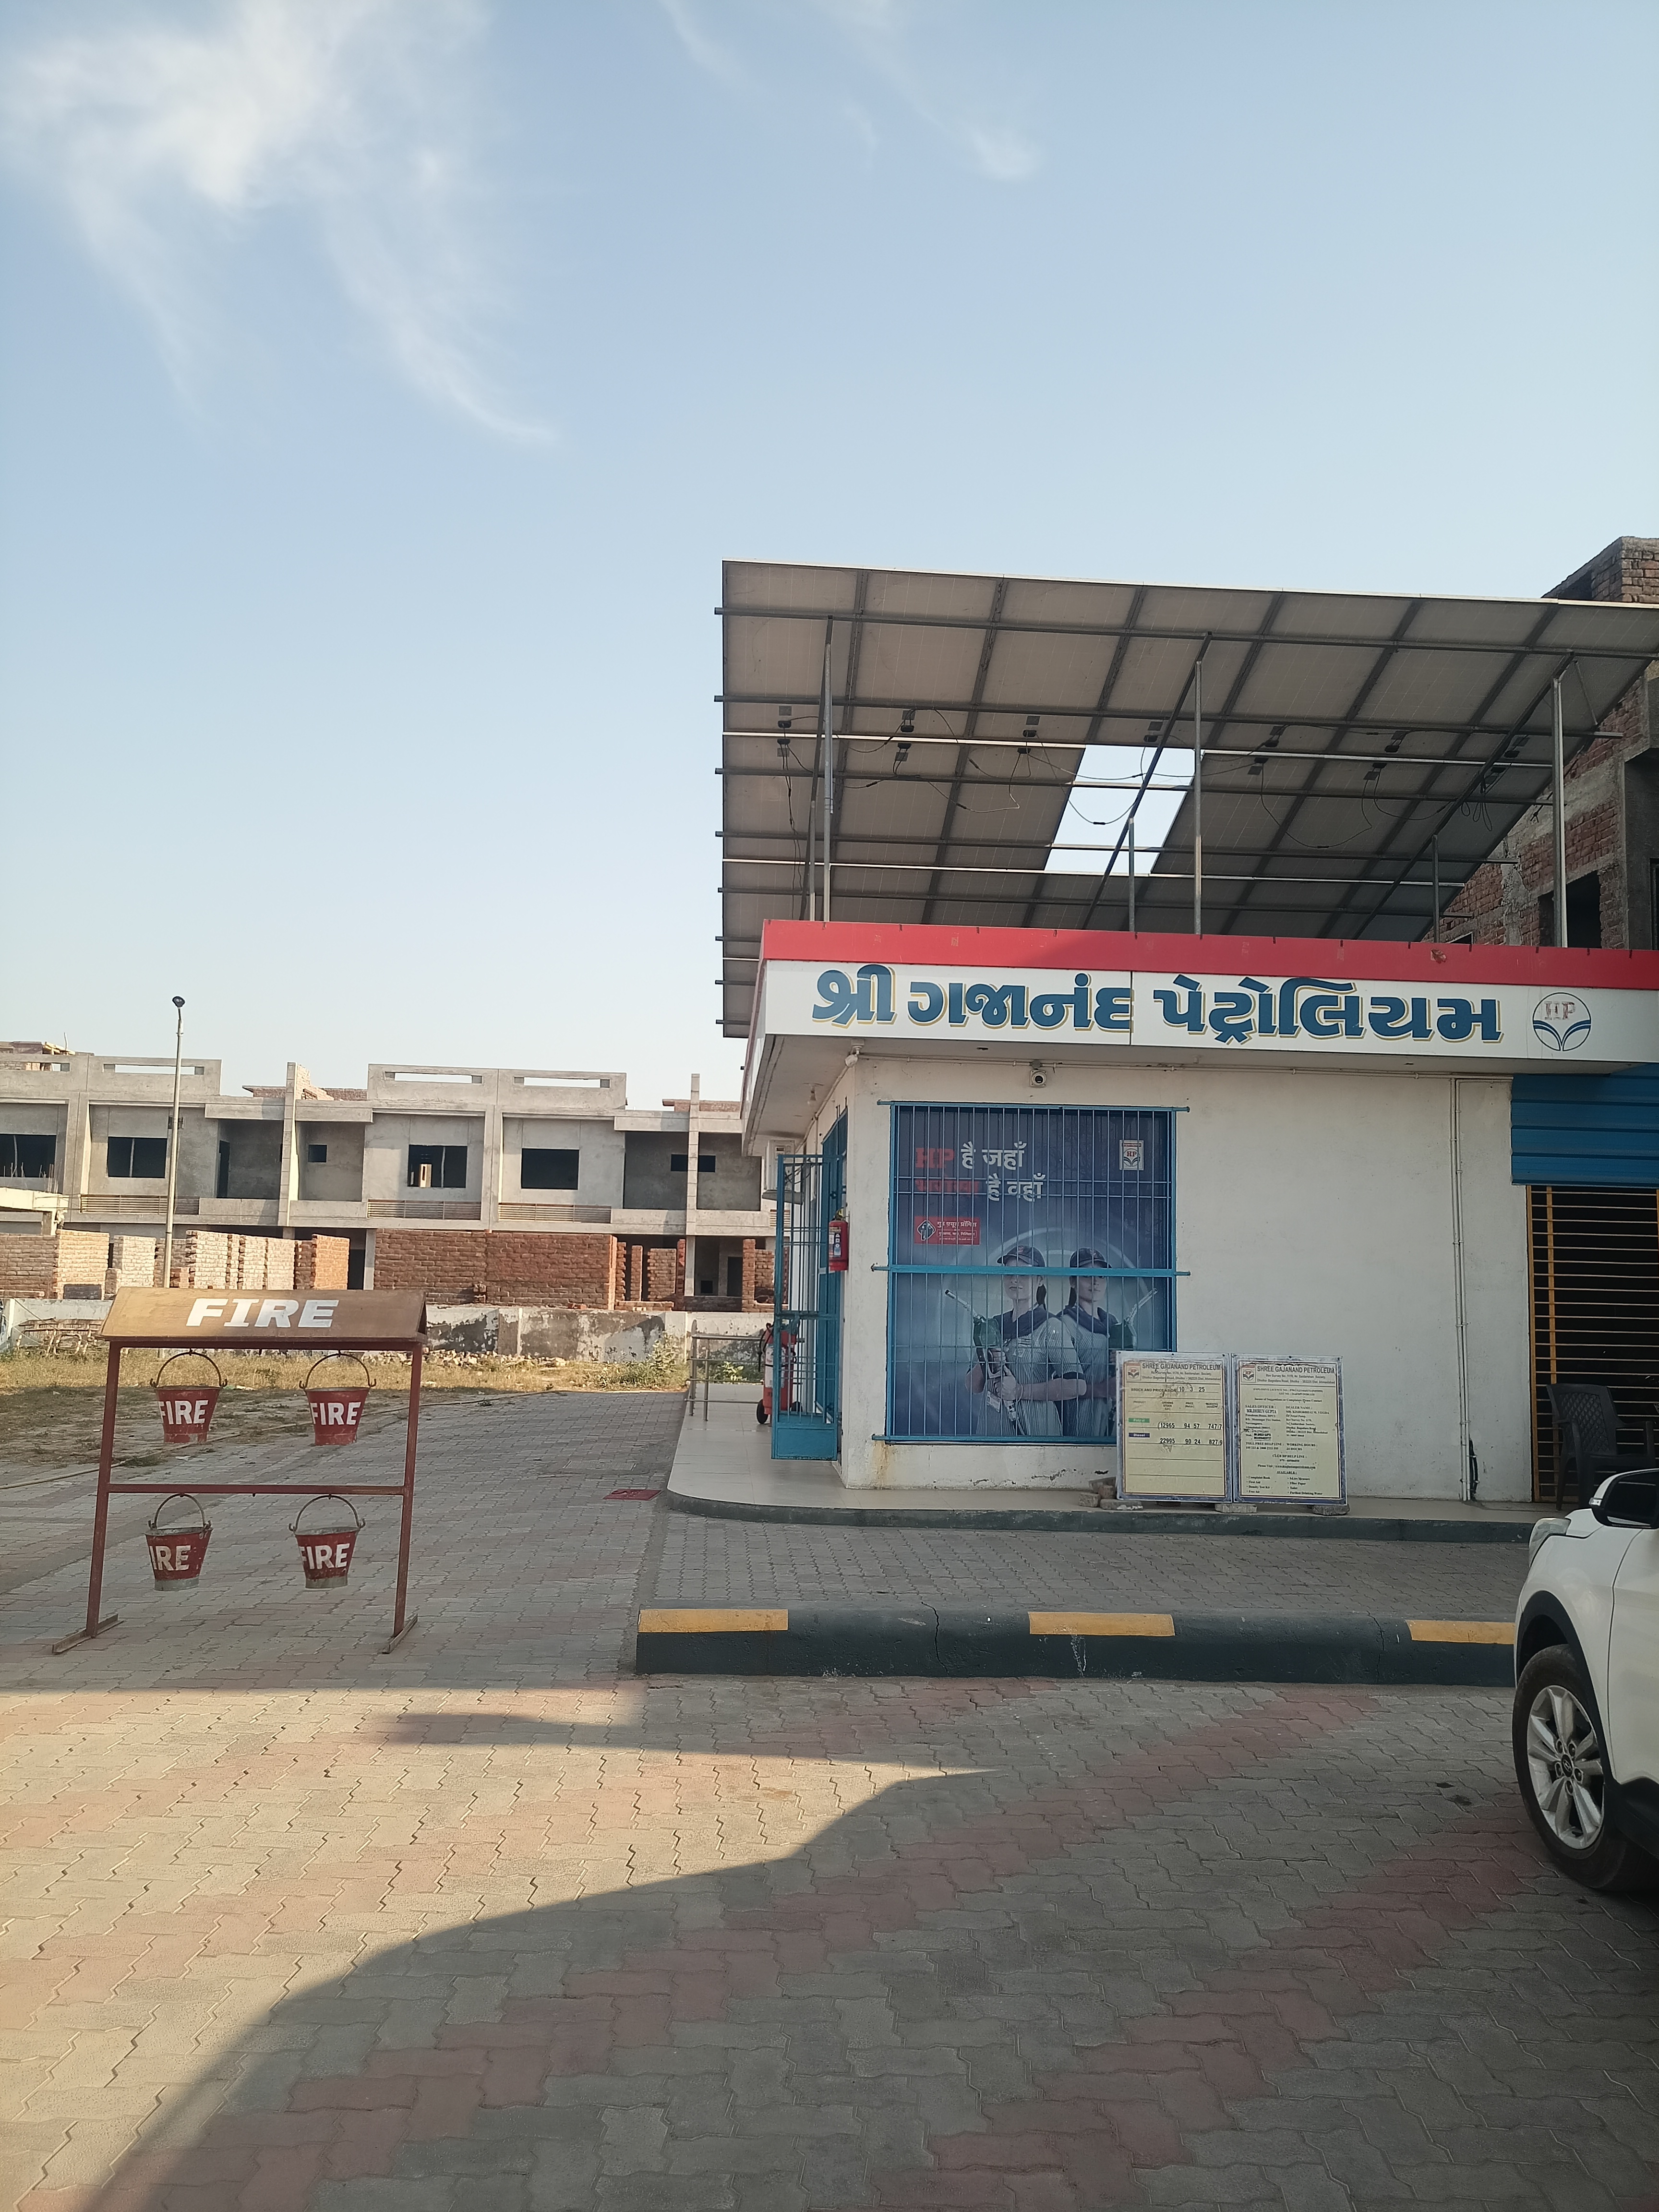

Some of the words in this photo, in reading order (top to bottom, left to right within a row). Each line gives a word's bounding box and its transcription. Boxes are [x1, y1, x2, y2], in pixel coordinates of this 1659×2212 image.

[812, 964, 897, 1029] શ્રી
[907, 973, 1134, 1032] ગજાનંદ
[1153, 974, 1504, 1044] પેટ્રોલિયમ
[1544, 1001, 1575, 1020] HP
[915, 1147, 955, 1168] HP
[961, 1141, 975, 1169] है
[982, 1141, 1027, 1170] जहाँ
[986, 1173, 1001, 1201] है
[1007, 1173, 1046, 1202] वहाँ
[185, 1298, 339, 1328] FIRE
[310, 1402, 361, 1425] FIRE
[149, 1545, 191, 1571] IRE
